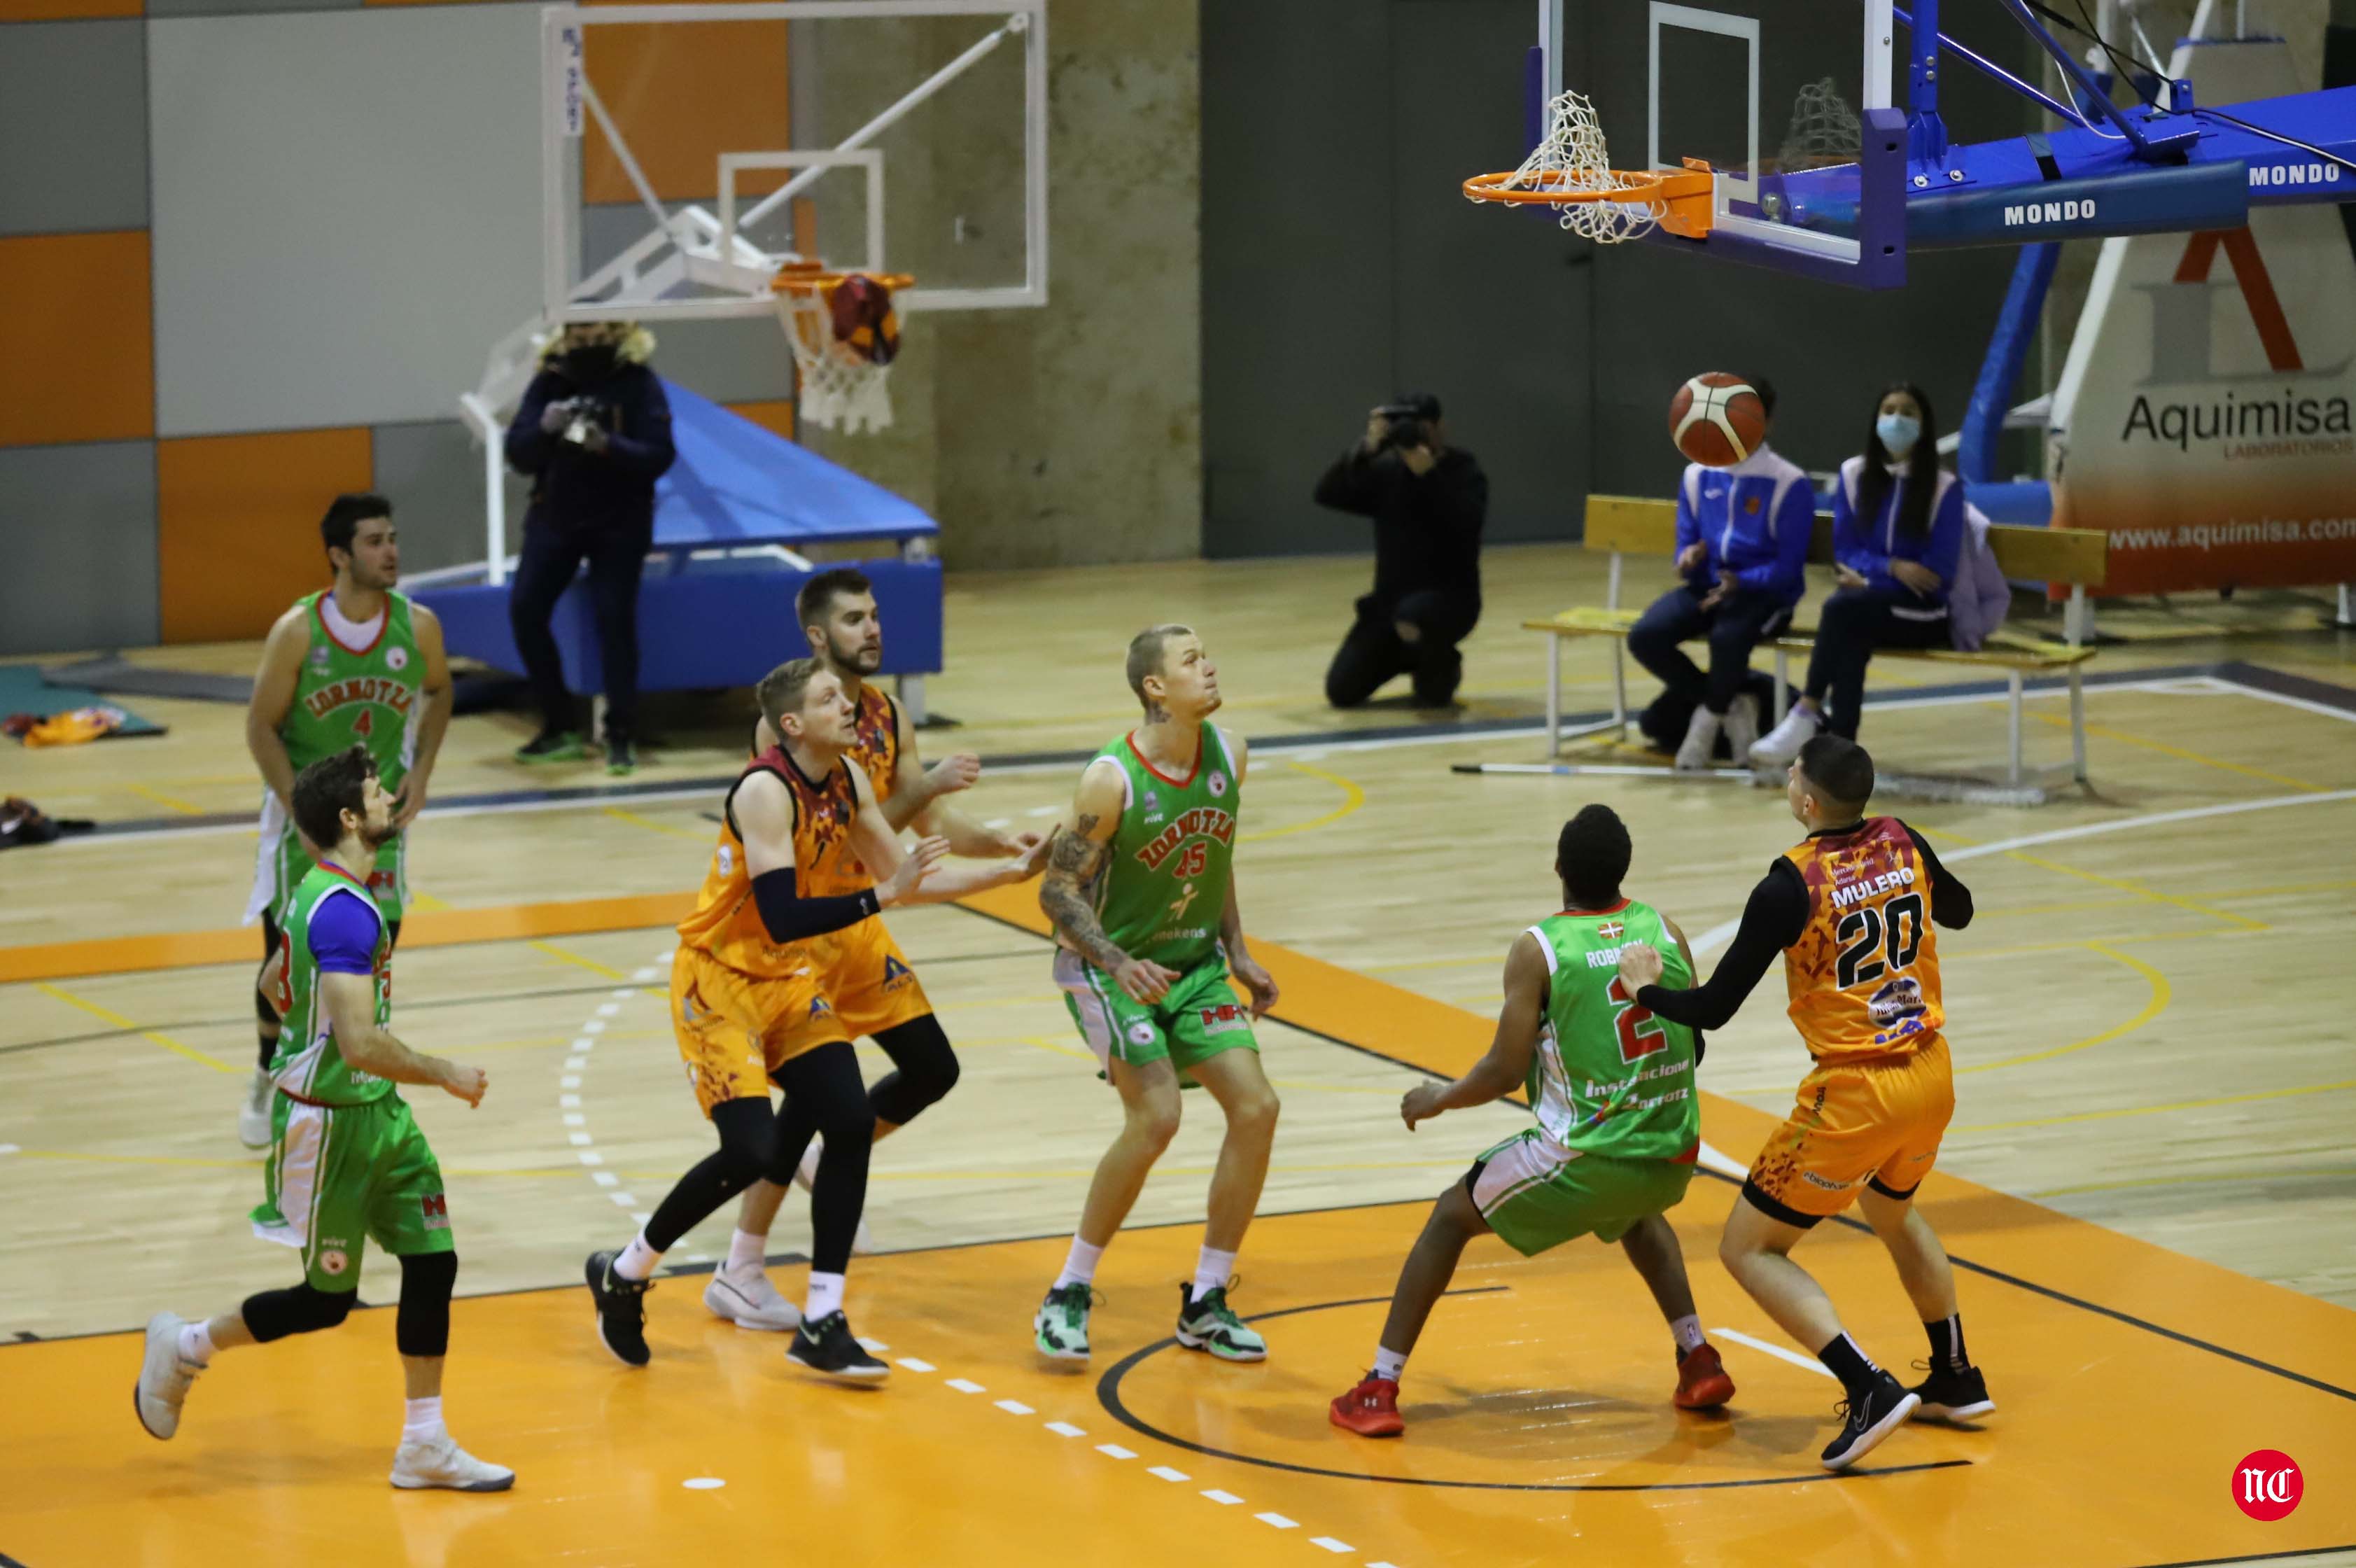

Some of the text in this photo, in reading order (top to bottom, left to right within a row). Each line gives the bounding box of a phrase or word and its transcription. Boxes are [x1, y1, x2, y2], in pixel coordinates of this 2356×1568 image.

[2249, 163, 2340, 186] MONDO
[2004, 199, 2096, 225] MONDO
[2121, 388, 2352, 453] Aquimisa
[1831, 867, 1916, 909] MULERO
[1835, 892, 1924, 991] 20
[1606, 974, 1667, 1065] 2
